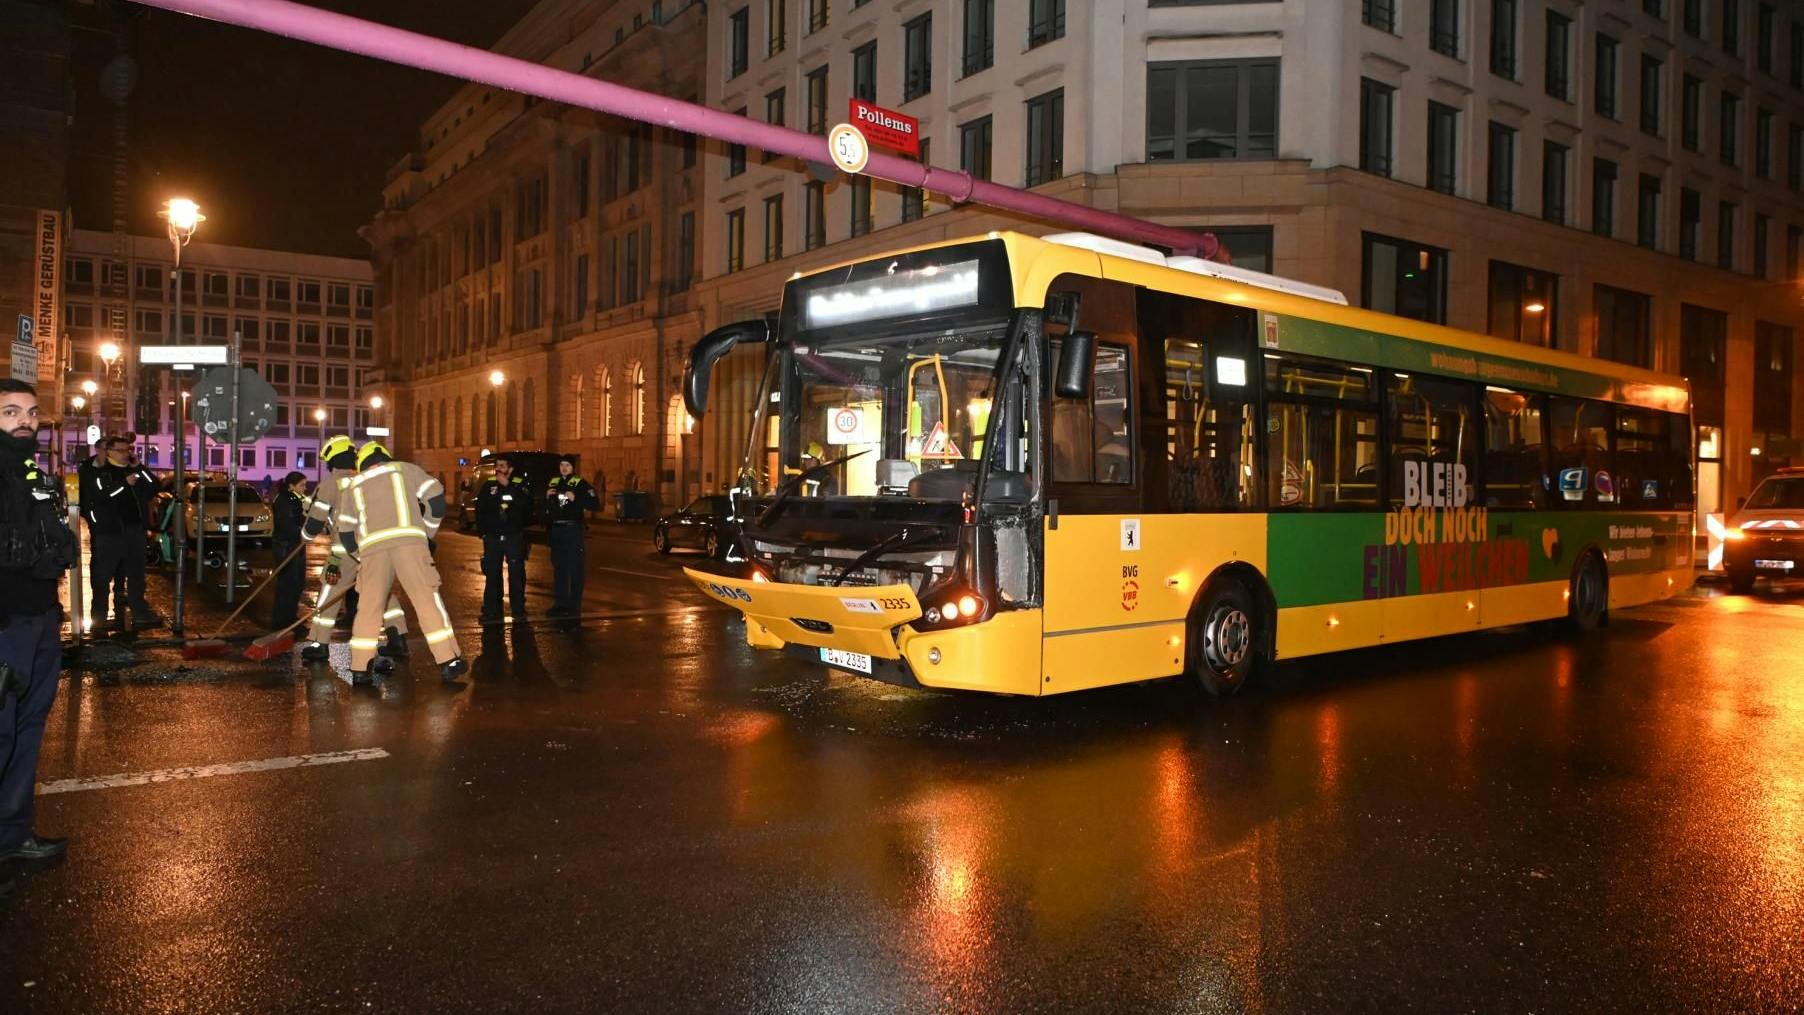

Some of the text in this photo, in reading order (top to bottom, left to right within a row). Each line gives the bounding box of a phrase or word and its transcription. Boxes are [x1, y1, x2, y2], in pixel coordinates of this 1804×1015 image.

[858, 105, 912, 134] Pollems
[40, 214, 56, 289] GERÜSTBAU
[39, 293, 53, 337] MENKE
[22, 319, 31, 340] P
[840, 416, 853, 428] 30
[1404, 460, 1468, 507] BLEIB
[1385, 506, 1488, 545] DOCH NOCH
[1122, 565, 1138, 578] BVG
[1363, 539, 1529, 599] EIN WEILCHEN
[880, 597, 911, 610] 2335
[1123, 590, 1137, 601] VBB
[846, 652, 867, 670] 2335
